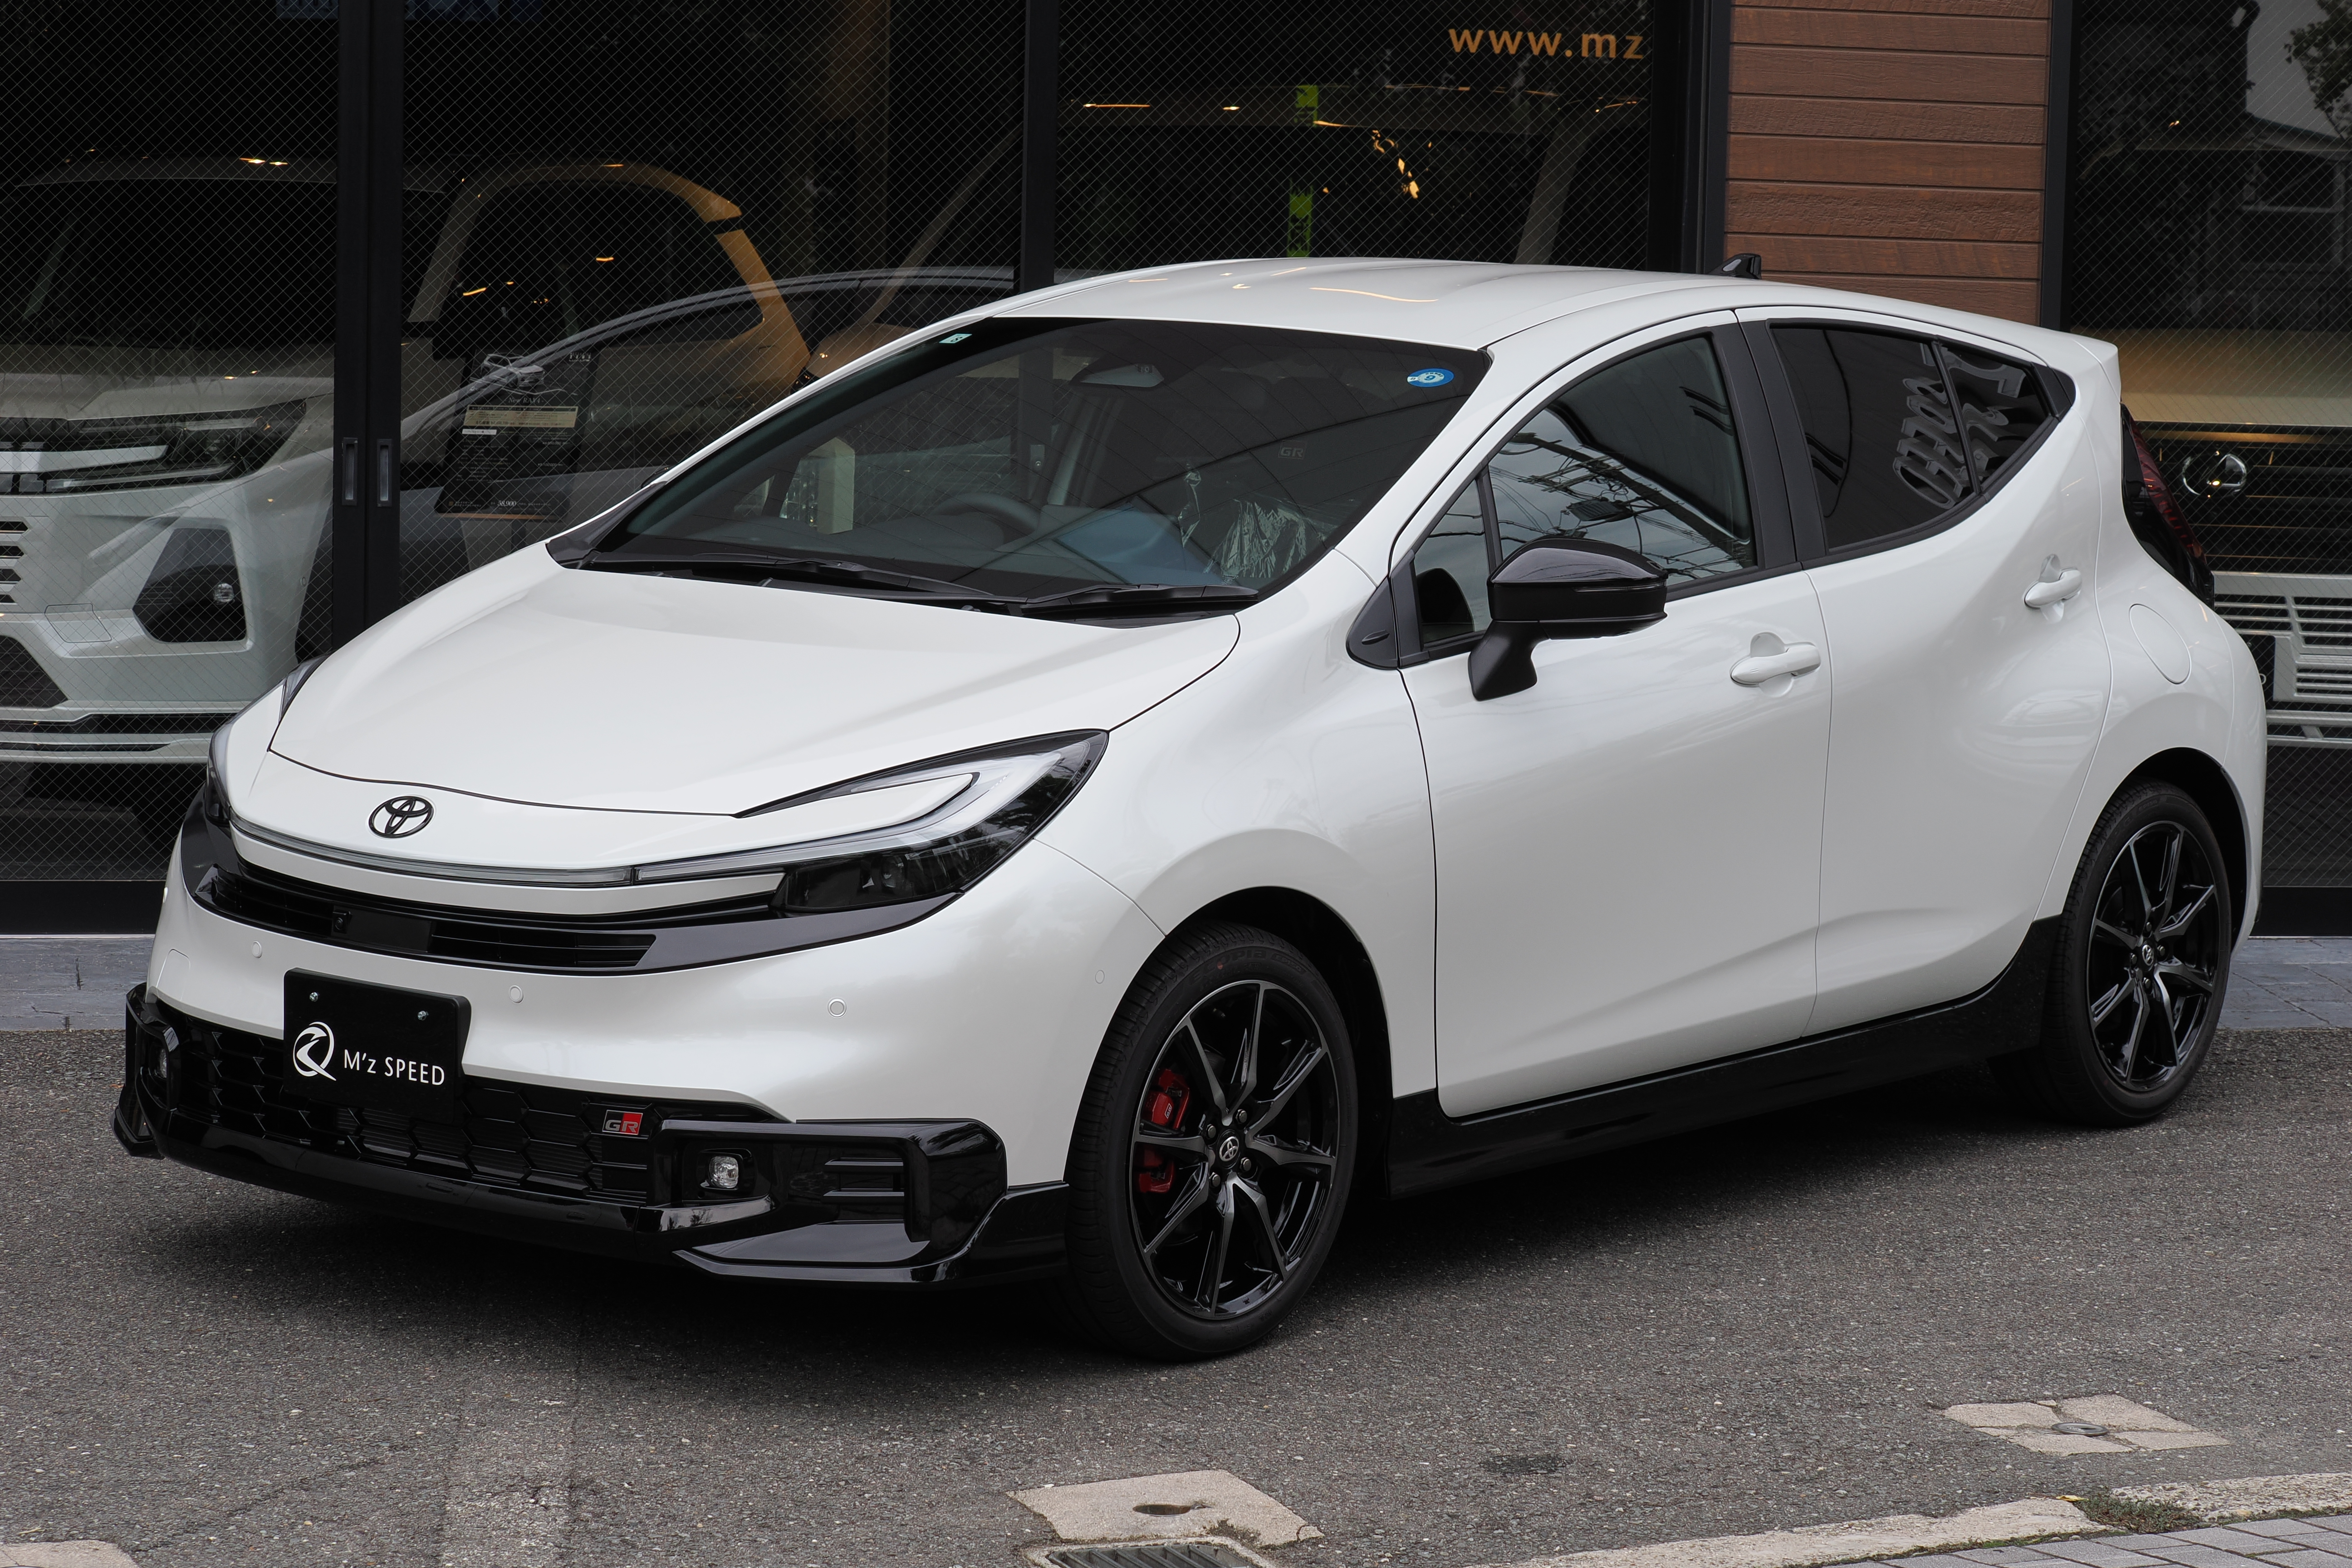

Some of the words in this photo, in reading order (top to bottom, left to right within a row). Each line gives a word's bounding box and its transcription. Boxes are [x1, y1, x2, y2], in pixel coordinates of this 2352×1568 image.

[1448, 29, 1644, 59] www.mz
[343, 1049, 376, 1074] M'z
[385, 1057, 445, 1086] SPEED
[605, 1120, 638, 1133] GR
